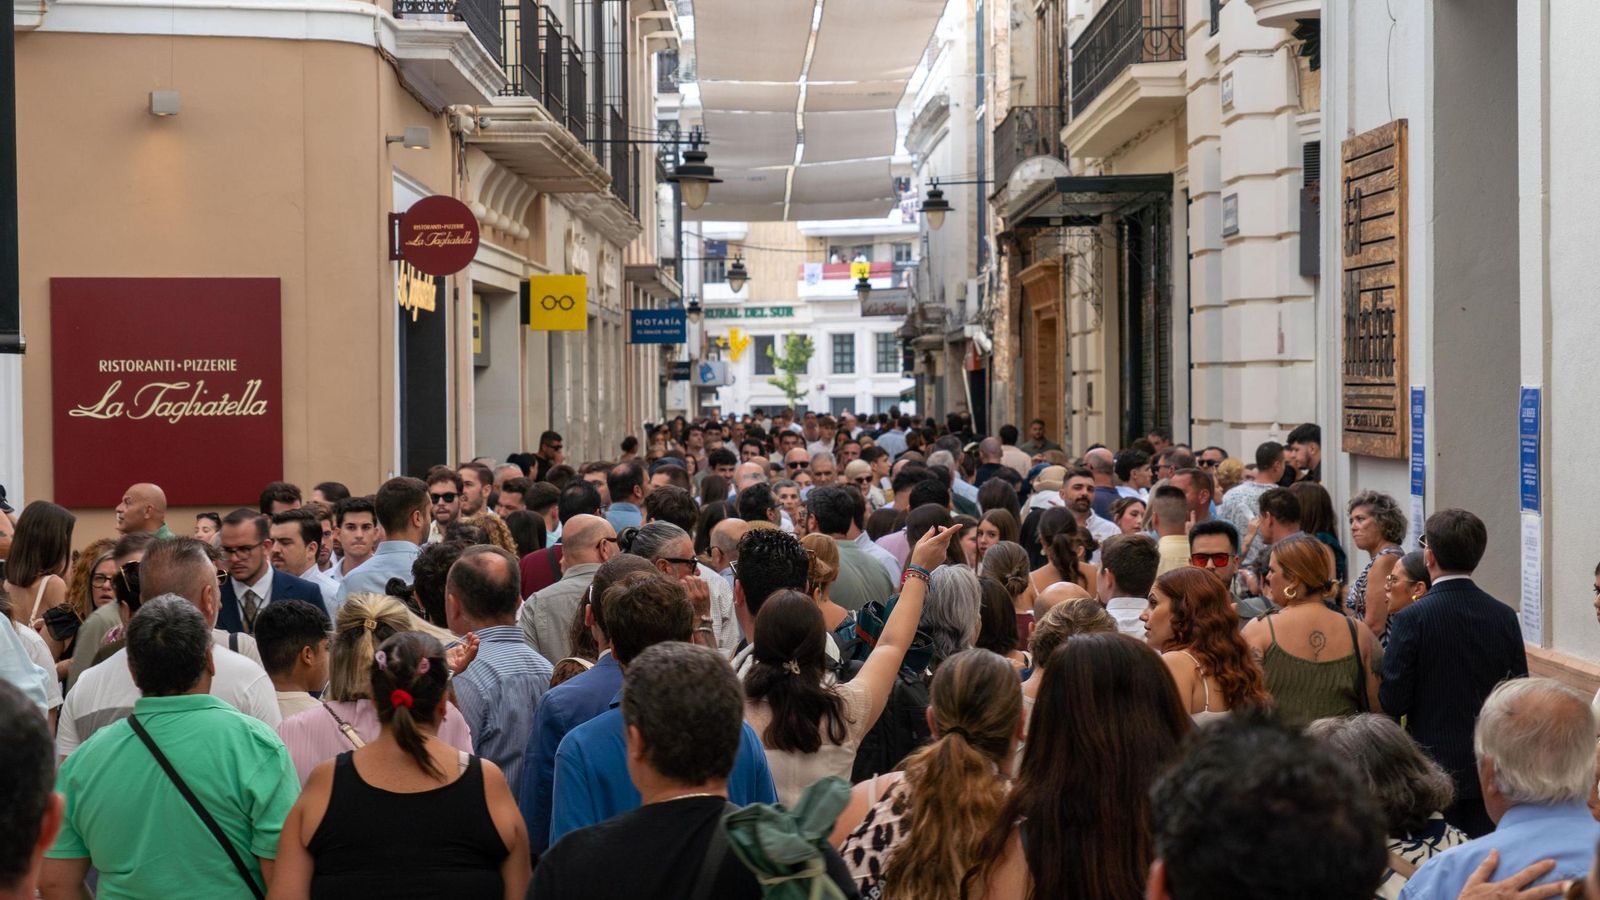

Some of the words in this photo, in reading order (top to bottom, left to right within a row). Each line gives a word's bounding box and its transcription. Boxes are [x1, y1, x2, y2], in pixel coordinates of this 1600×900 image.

[405, 232, 424, 246] La
[424, 231, 473, 247] Tagliatella
[744, 307, 767, 318] DEL
[770, 306, 794, 317] SUR
[635, 317, 681, 326] NOTARÍA
[99, 359, 175, 373] RISTORANTI
[183, 359, 237, 372] PIZZERIE
[68, 380, 125, 419] La
[126, 379, 268, 424] Tagliatella
